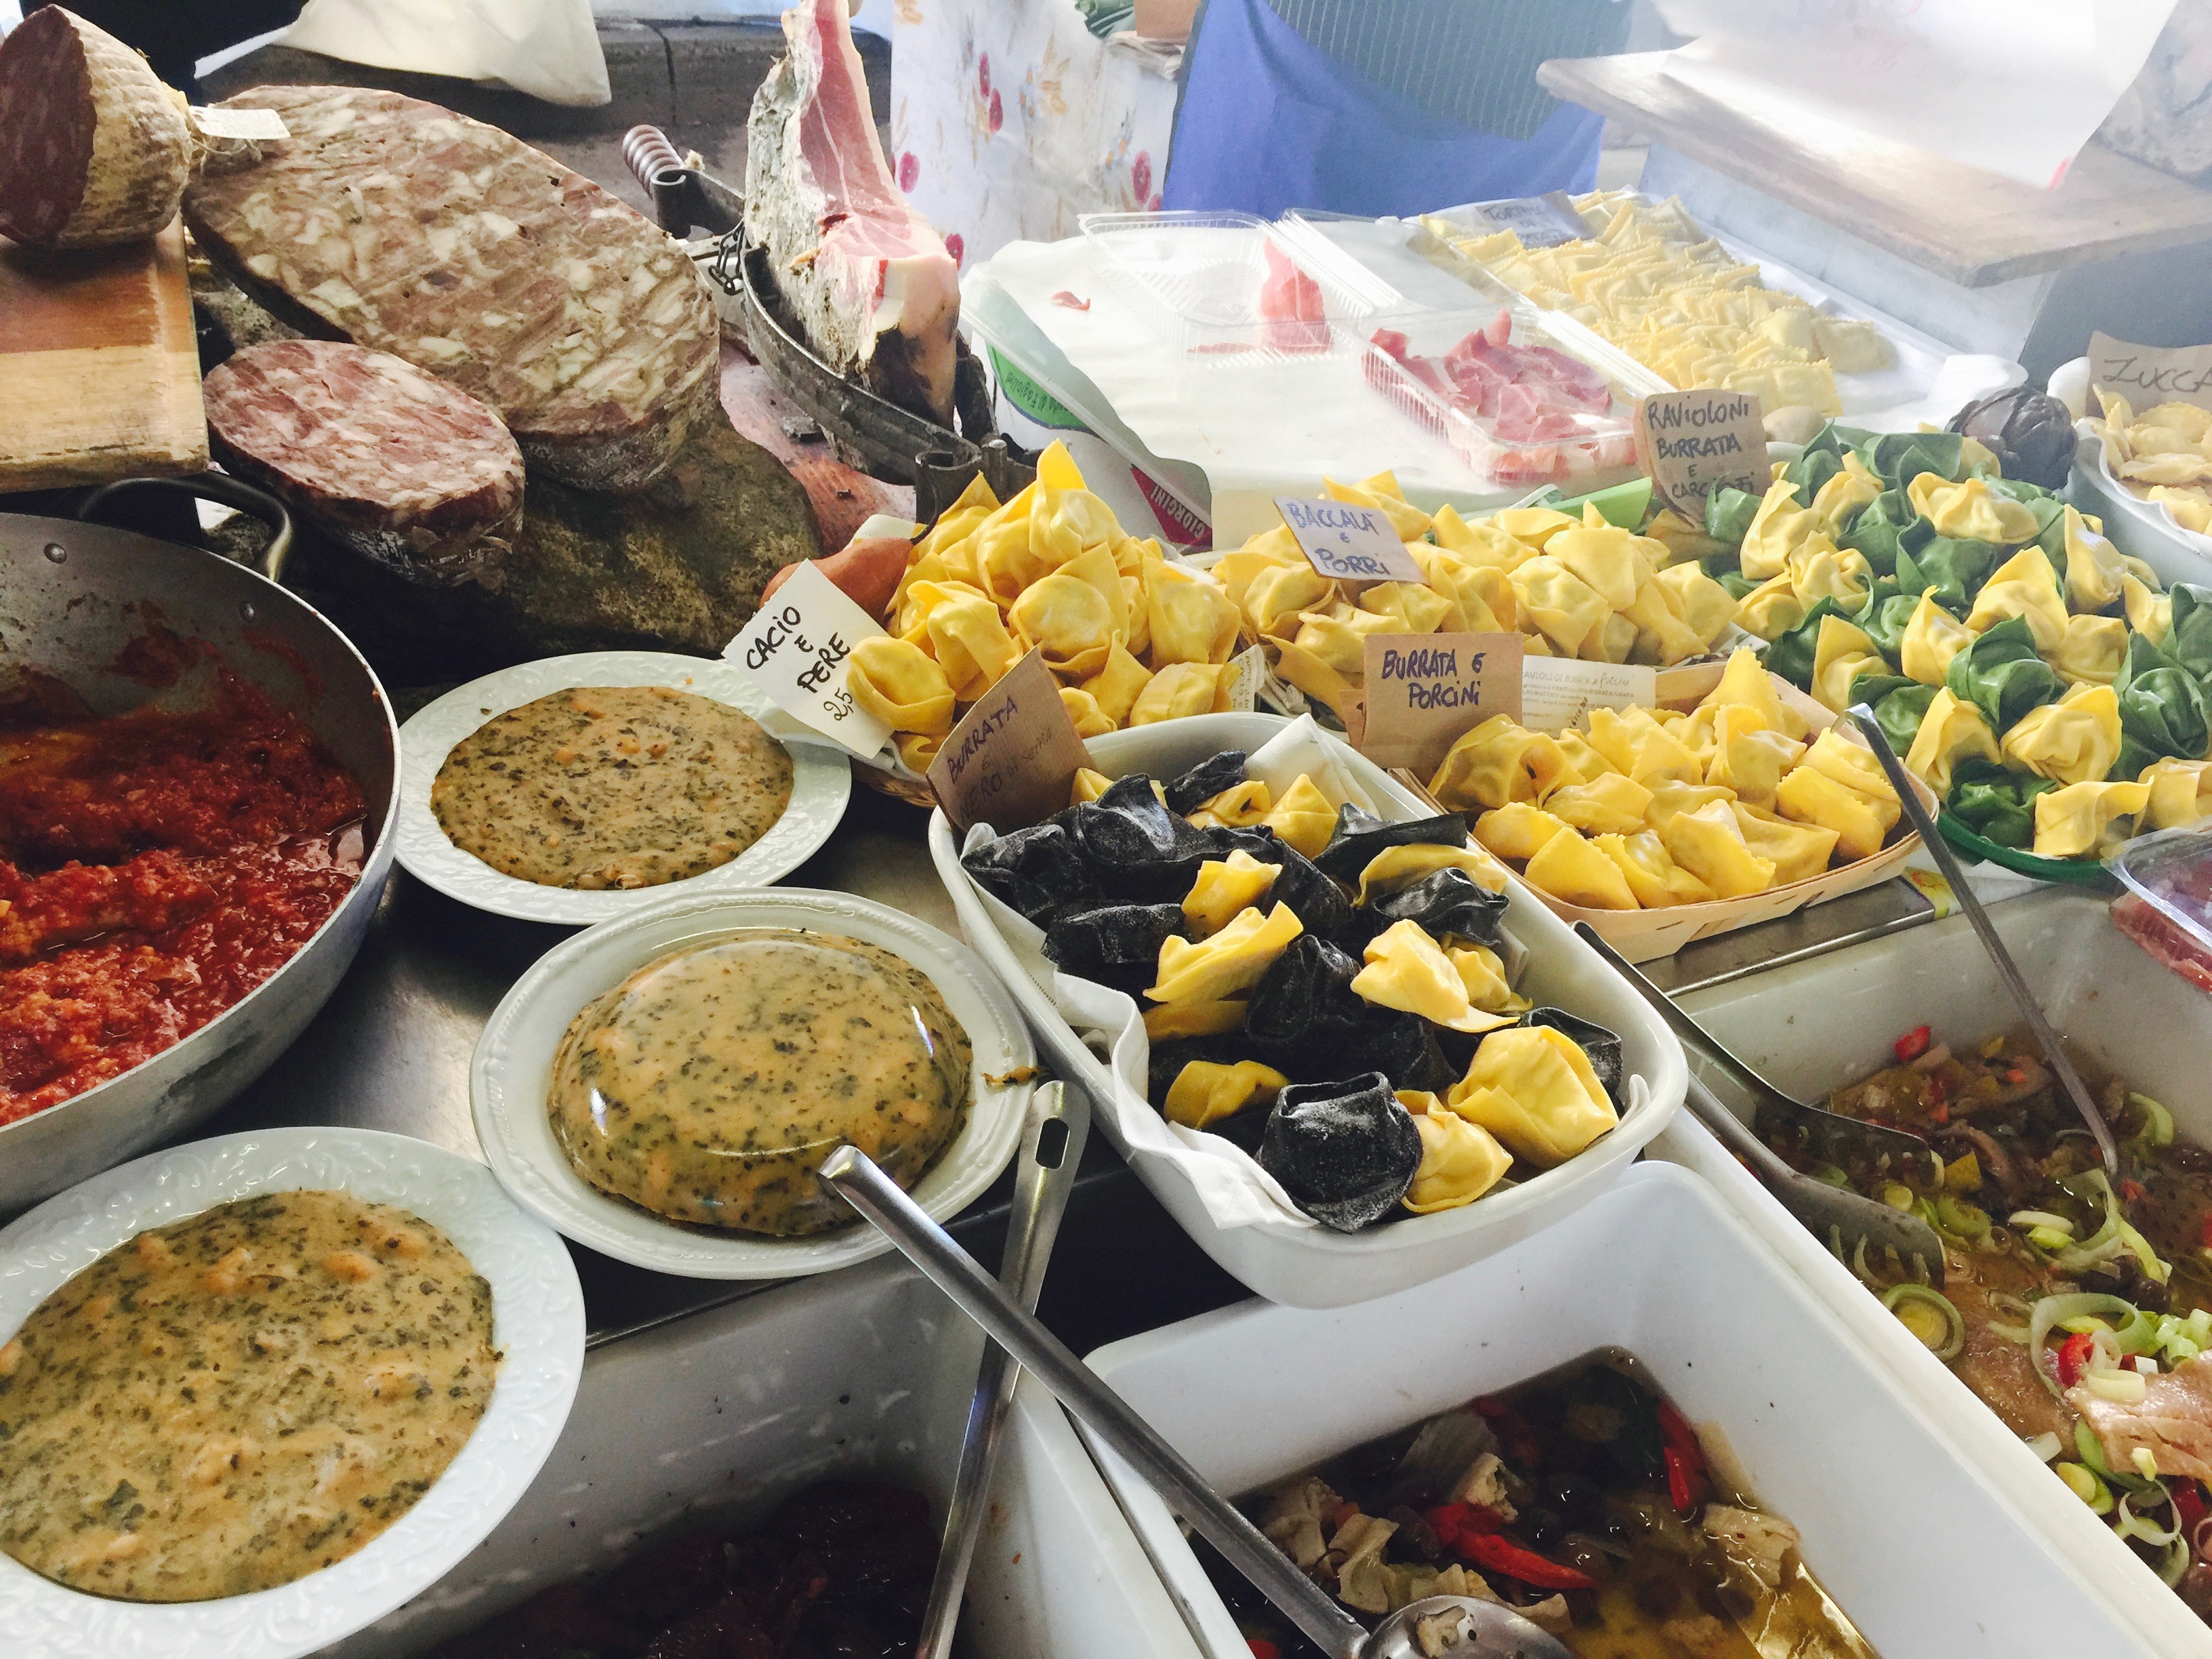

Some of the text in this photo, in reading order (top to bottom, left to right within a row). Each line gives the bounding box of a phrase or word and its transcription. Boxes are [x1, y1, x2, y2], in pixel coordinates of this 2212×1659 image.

[1647, 395, 1748, 430] RAVIOLONI
[1656, 432, 1742, 459] BURRATA
[1687, 464, 1697, 477] E
[1151, 483, 1205, 539] GIORGINI
[1315, 548, 1391, 575] PORRI
[746, 606, 801, 670] CACIO
[794, 634, 813, 653] E
[797, 632, 851, 693] PERE
[1381, 649, 1457, 680] BURRATA
[1522, 671, 1552, 681] AVIOLI
[1408, 680, 1481, 710] PORCINI
[947, 695, 1018, 784] BURRATA
